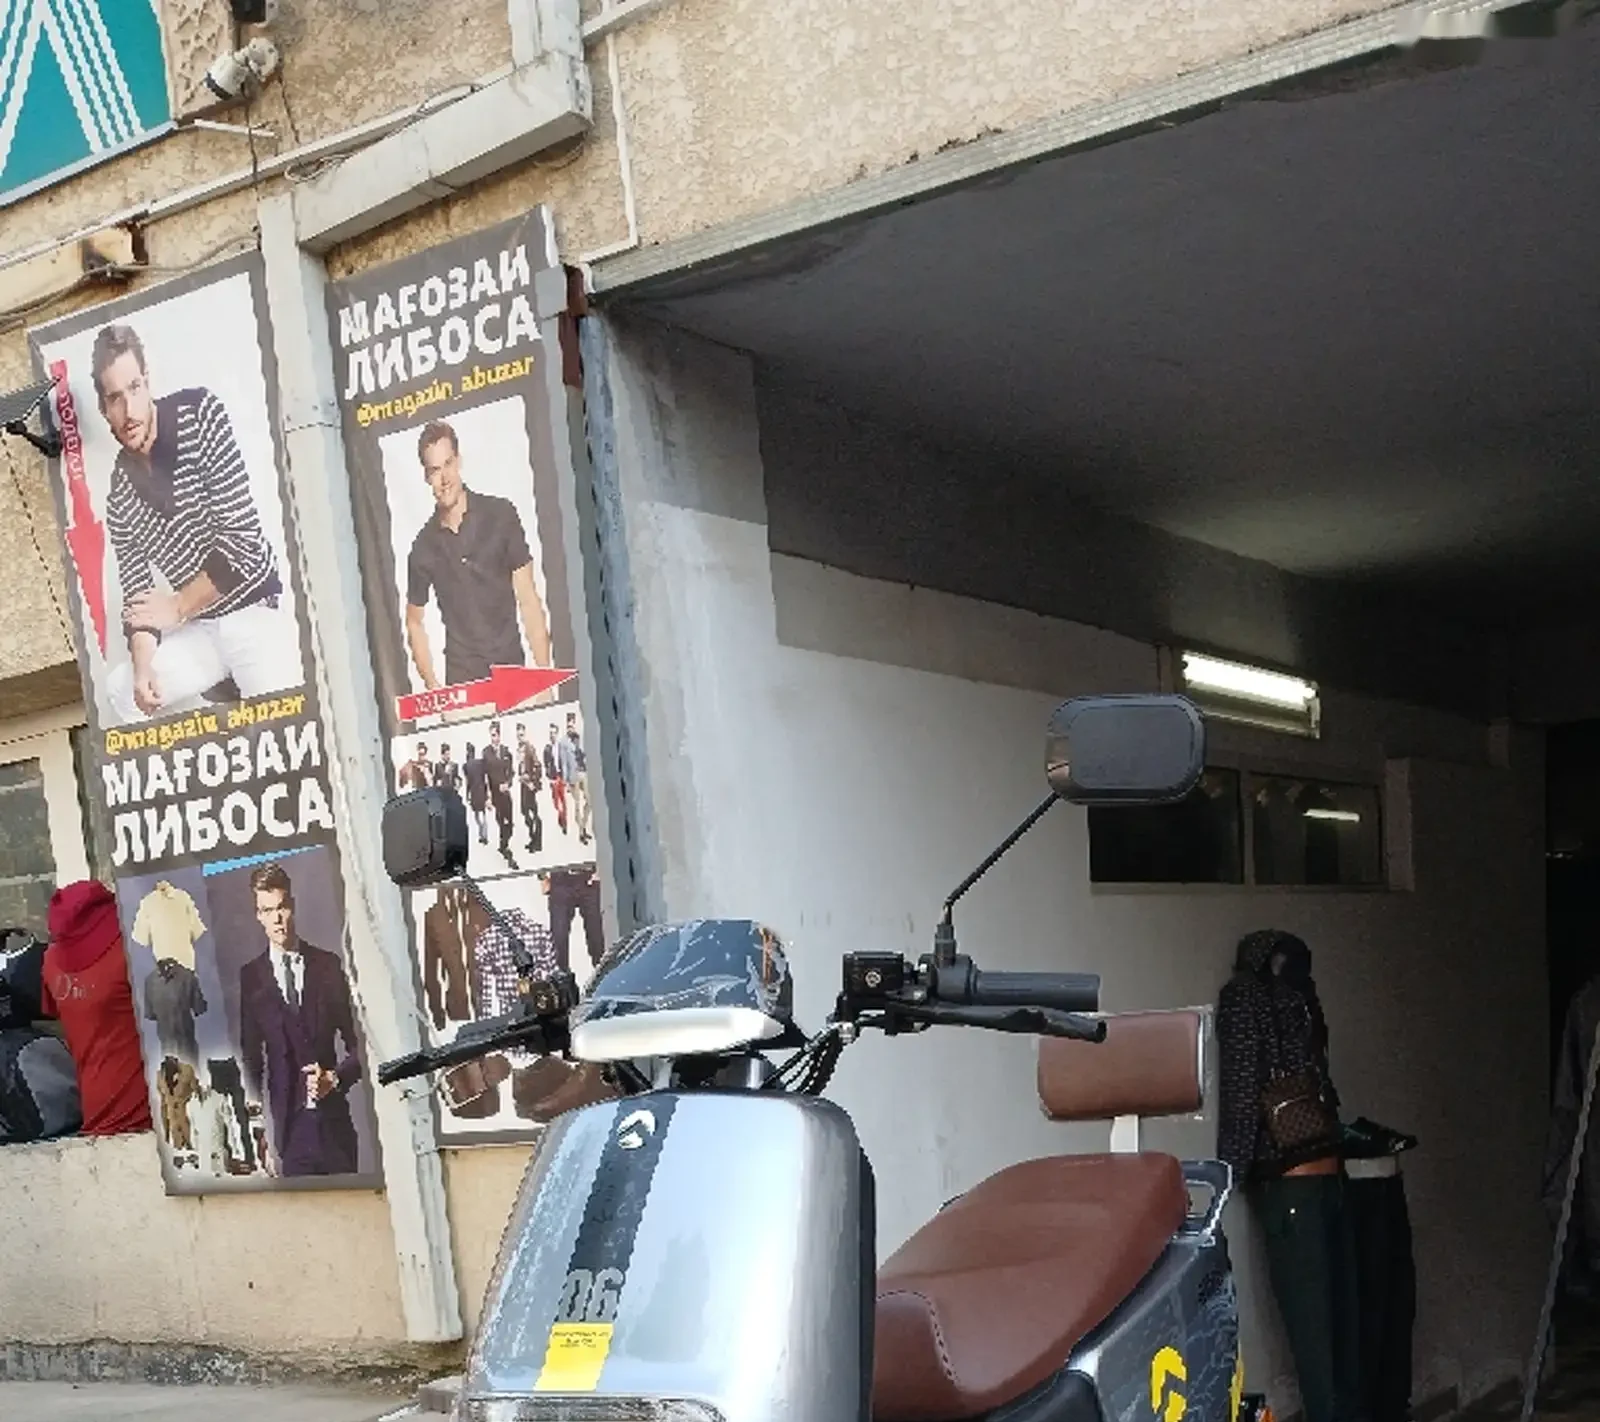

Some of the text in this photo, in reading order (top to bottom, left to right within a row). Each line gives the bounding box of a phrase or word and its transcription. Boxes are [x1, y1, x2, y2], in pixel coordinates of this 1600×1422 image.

[344, 294, 543, 400] ЛИБОСА
[110, 777, 336, 867] ЛИБОСА
[53, 973, 95, 1001] Dio
